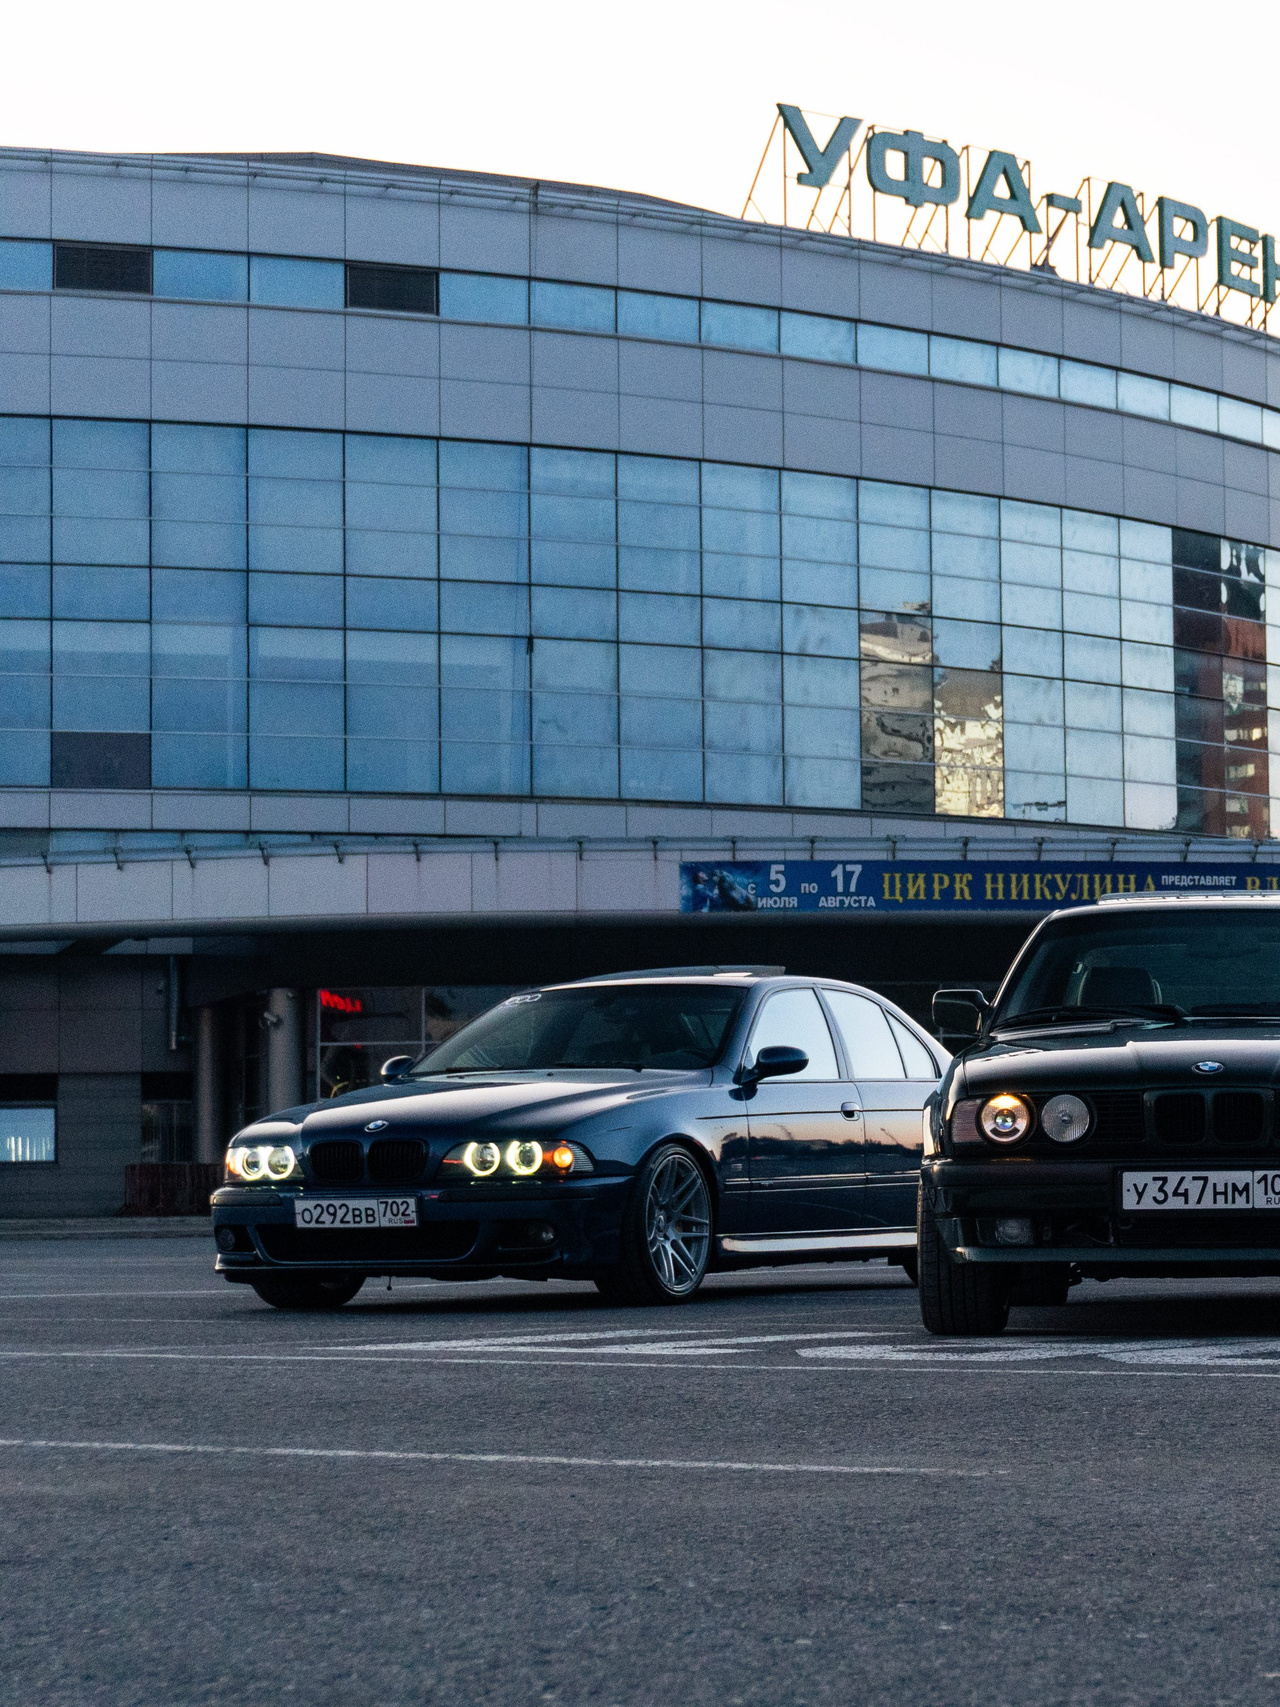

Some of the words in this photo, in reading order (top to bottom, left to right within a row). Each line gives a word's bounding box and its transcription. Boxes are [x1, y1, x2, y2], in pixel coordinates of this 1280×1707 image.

[768, 864, 787, 893] 5
[801, 882, 819, 894] по
[830, 864, 863, 893] 17
[882, 872, 973, 903] ЦИРК
[984, 872, 1157, 902] НИКУЛИНА
[1161, 875, 1237, 887] ПРЕДСТАВЛЯЕТ
[757, 896, 798, 909] ИЮЛЯ
[818, 896, 876, 908] АВГУСТА
[1133, 1176, 1250, 1205] У347НМ
[301, 1203, 376, 1224] О292ВВ
[379, 1201, 411, 1217] 702
